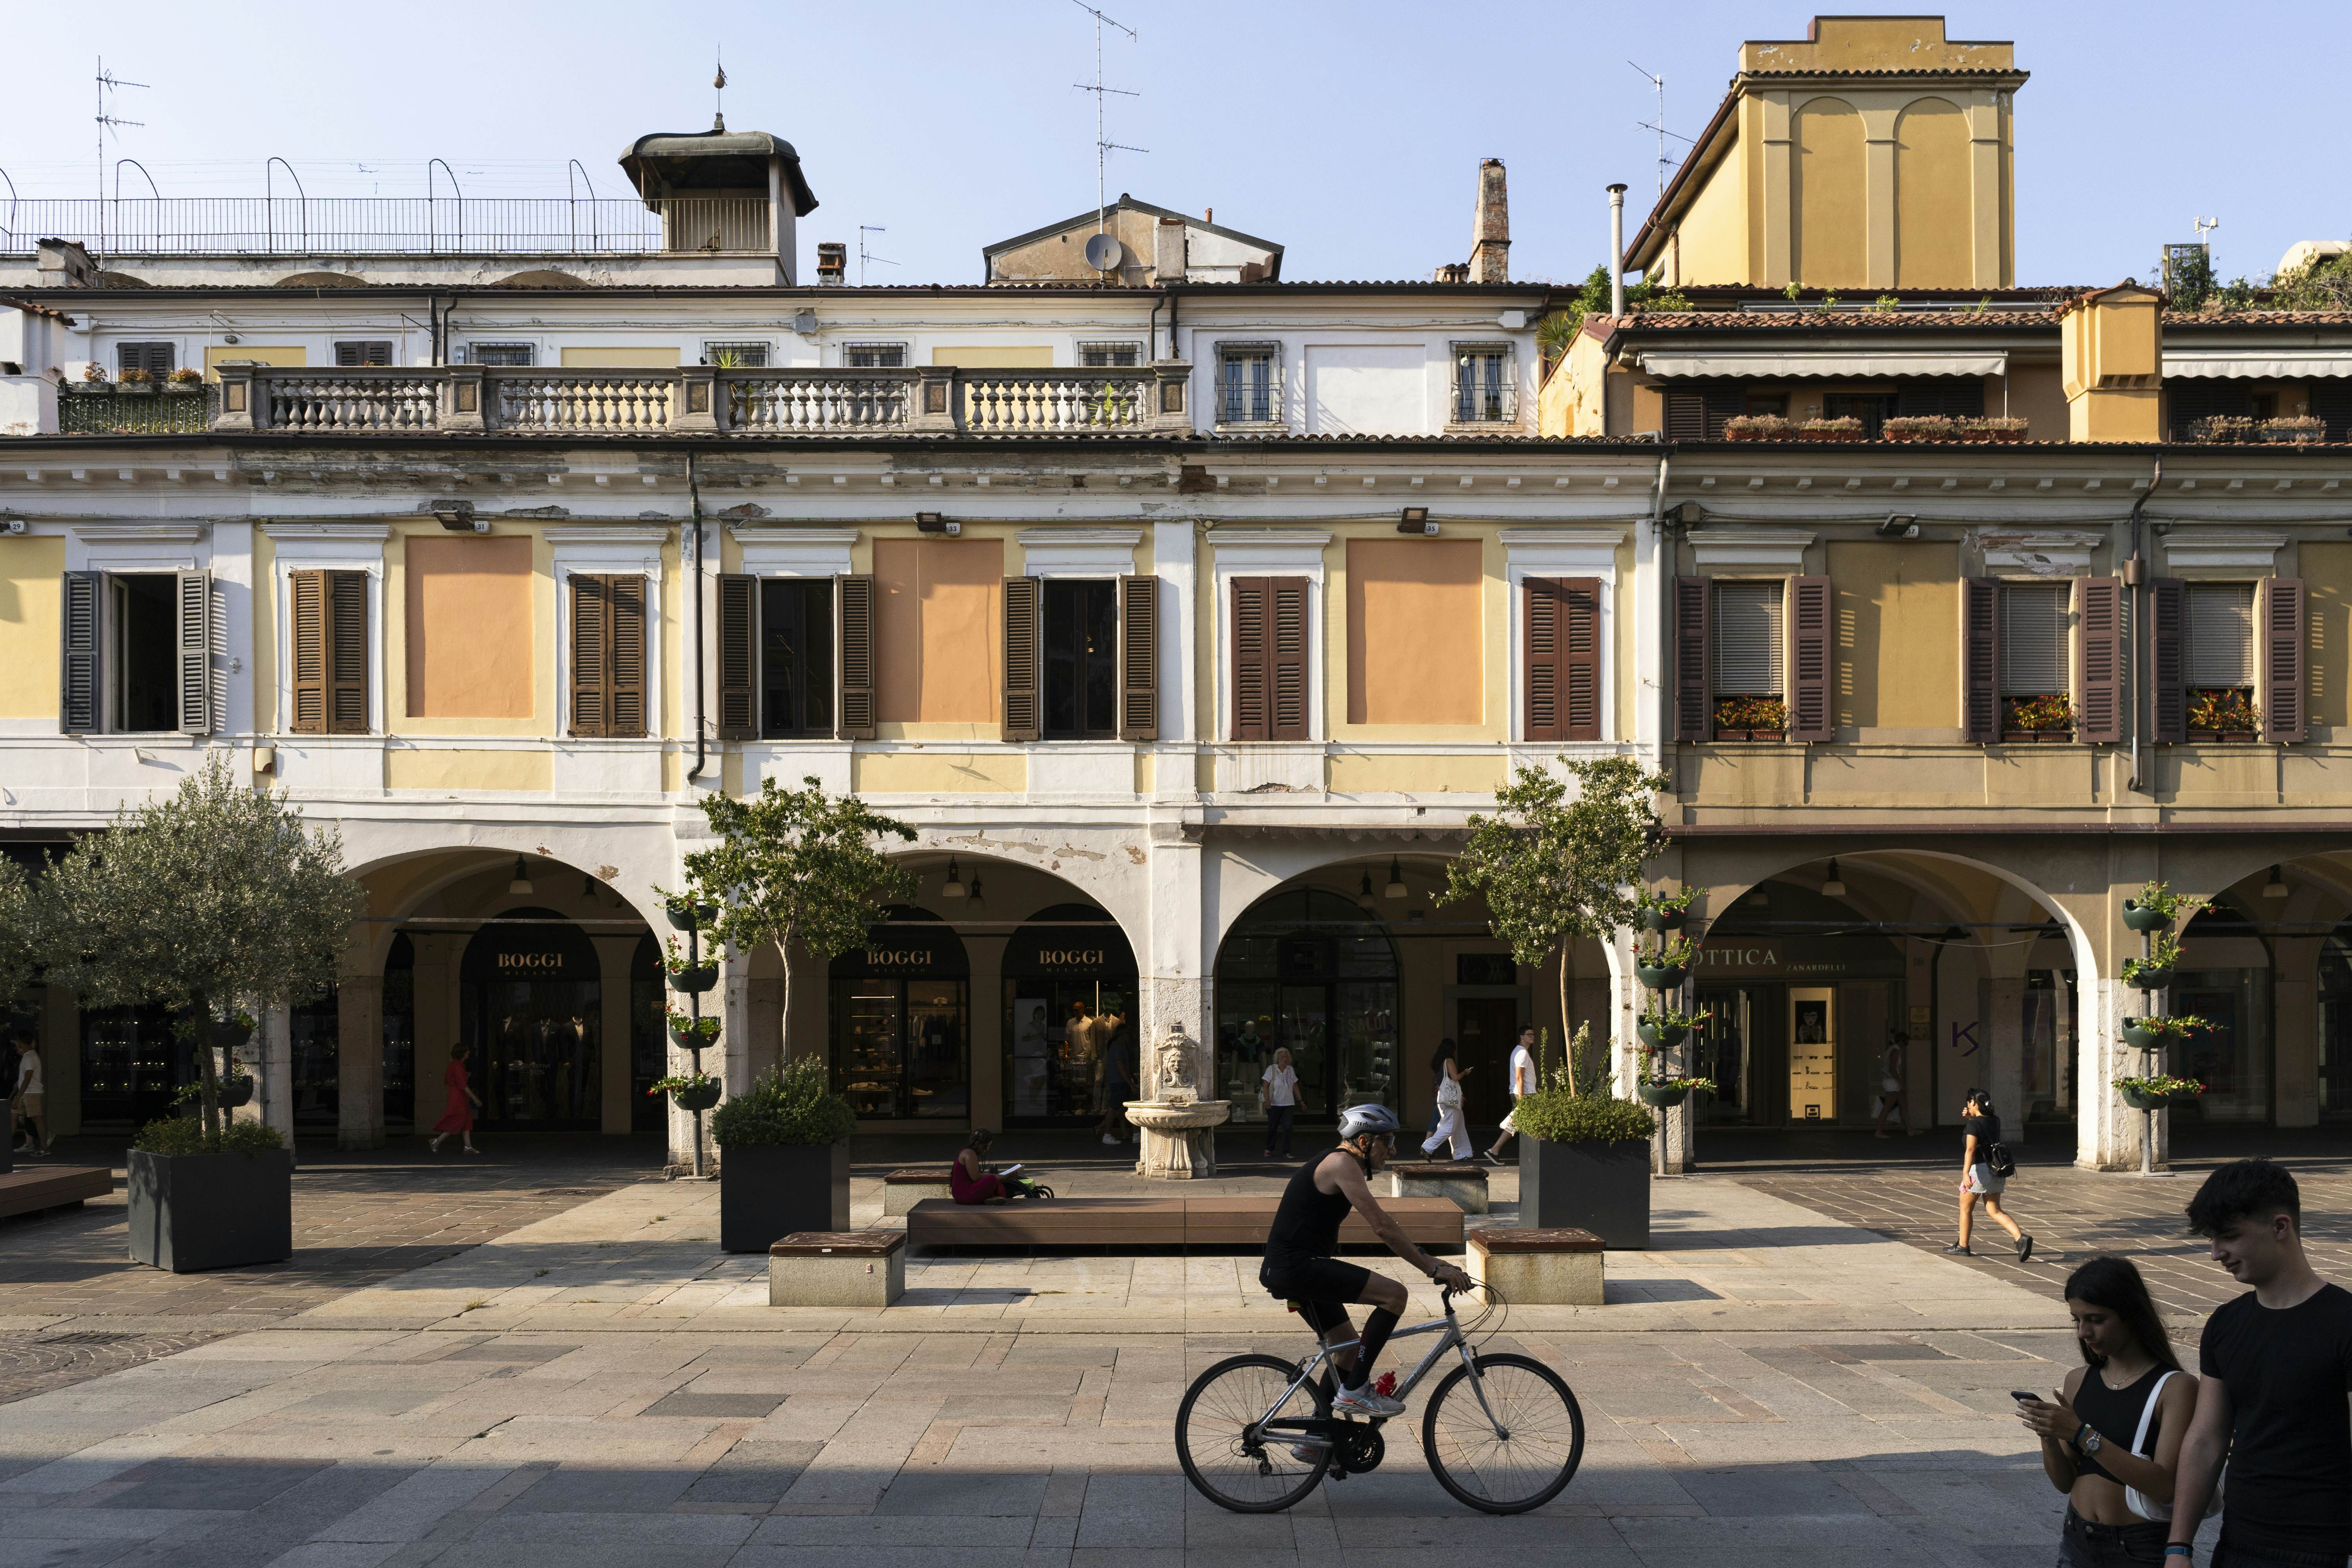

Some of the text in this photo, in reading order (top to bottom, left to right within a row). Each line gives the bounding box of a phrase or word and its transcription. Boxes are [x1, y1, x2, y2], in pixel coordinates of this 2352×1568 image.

[498, 953, 564, 967] BOGGI
[867, 951, 932, 965] BOGGI
[1039, 950, 1104, 964] BOGGI
[1348, 1016, 1387, 1033] SALDI
[1358, 1345, 1366, 1359] SOX
